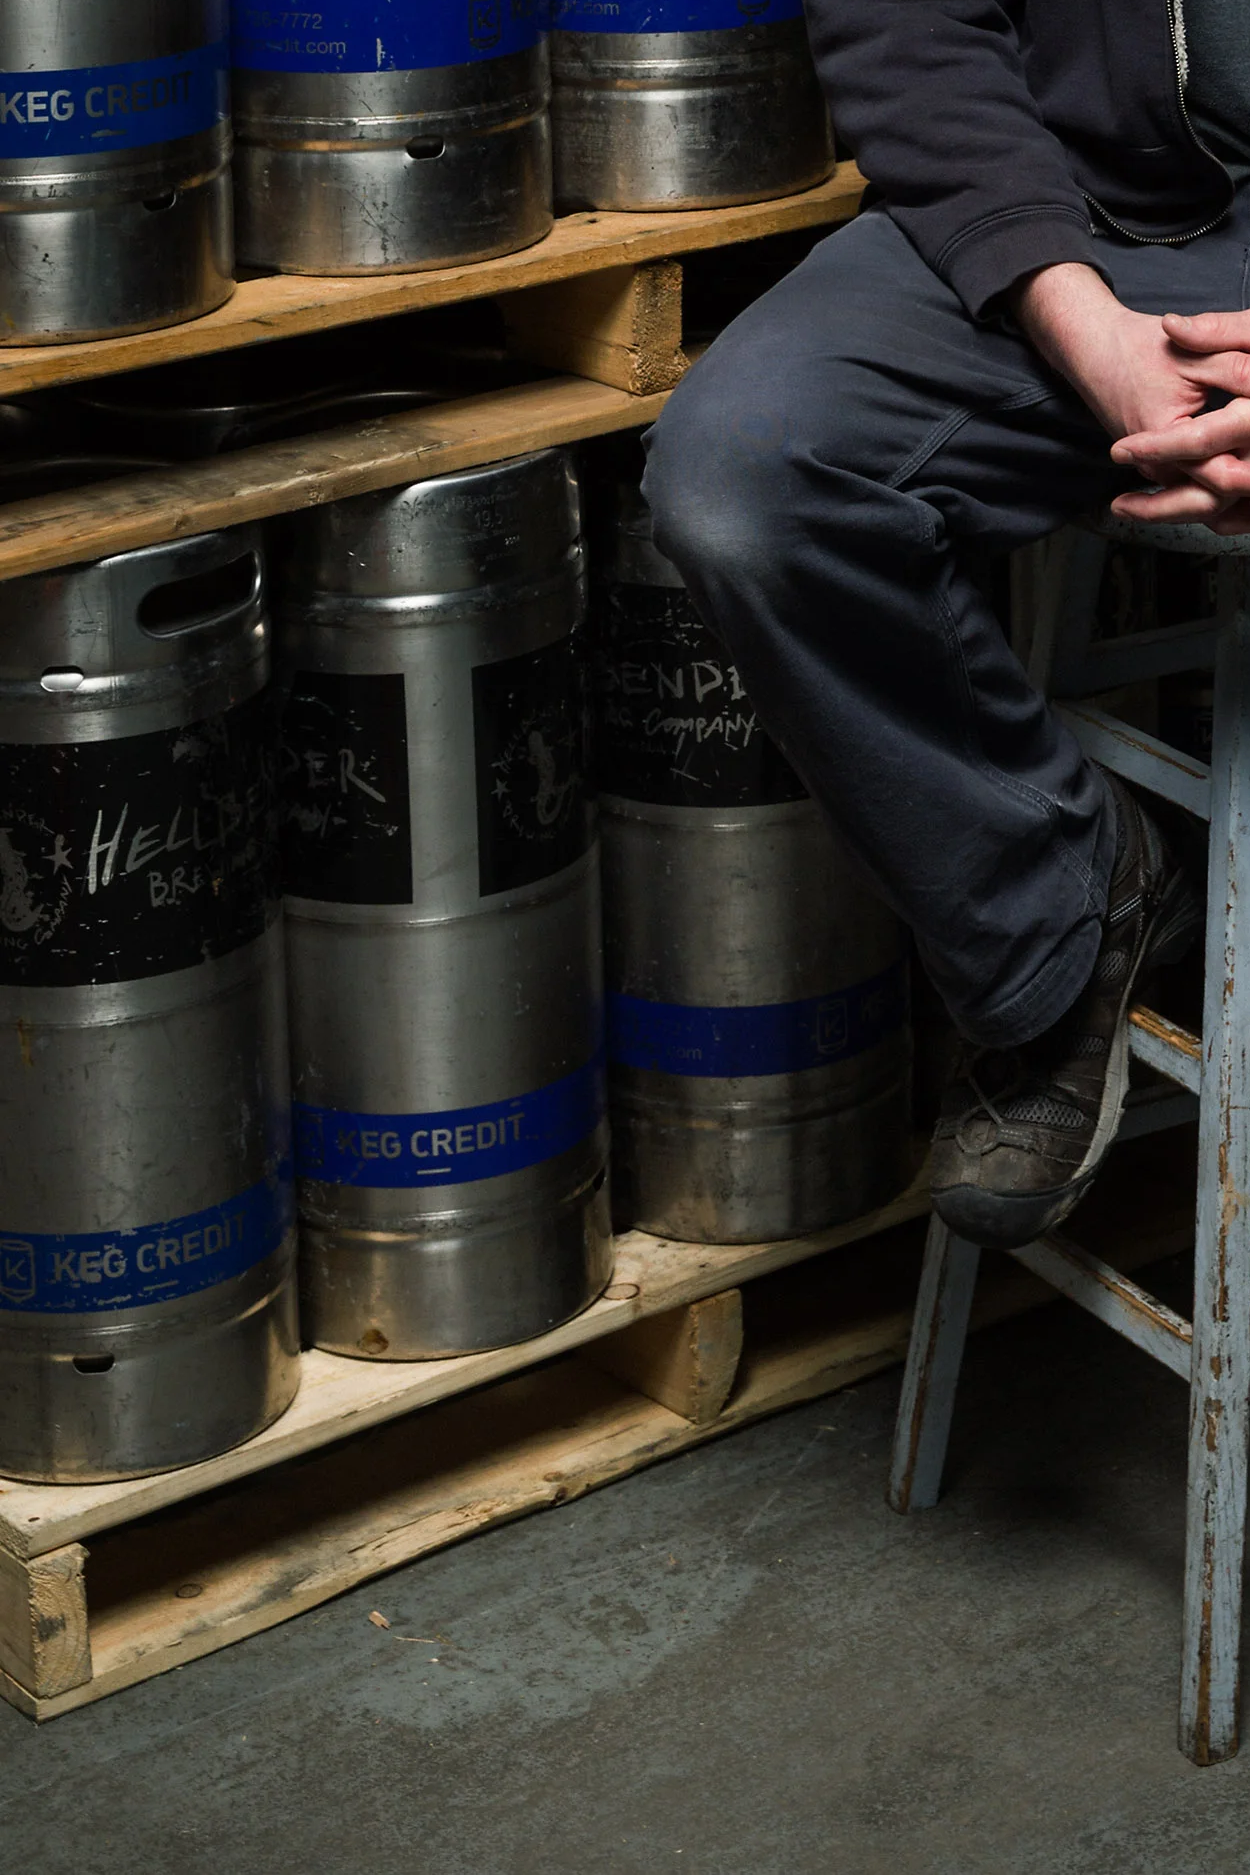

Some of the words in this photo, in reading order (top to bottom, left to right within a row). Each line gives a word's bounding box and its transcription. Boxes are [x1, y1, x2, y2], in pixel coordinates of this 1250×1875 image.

[0, 88, 76, 125] KEG
[84, 69, 194, 119] CREDIT
[643, 706, 758, 748] COMPANY
[337, 1128, 402, 1160] KEG
[410, 1111, 526, 1159] CREDIT
[52, 1243, 129, 1284] KEG
[135, 1209, 248, 1274] CREDIT
